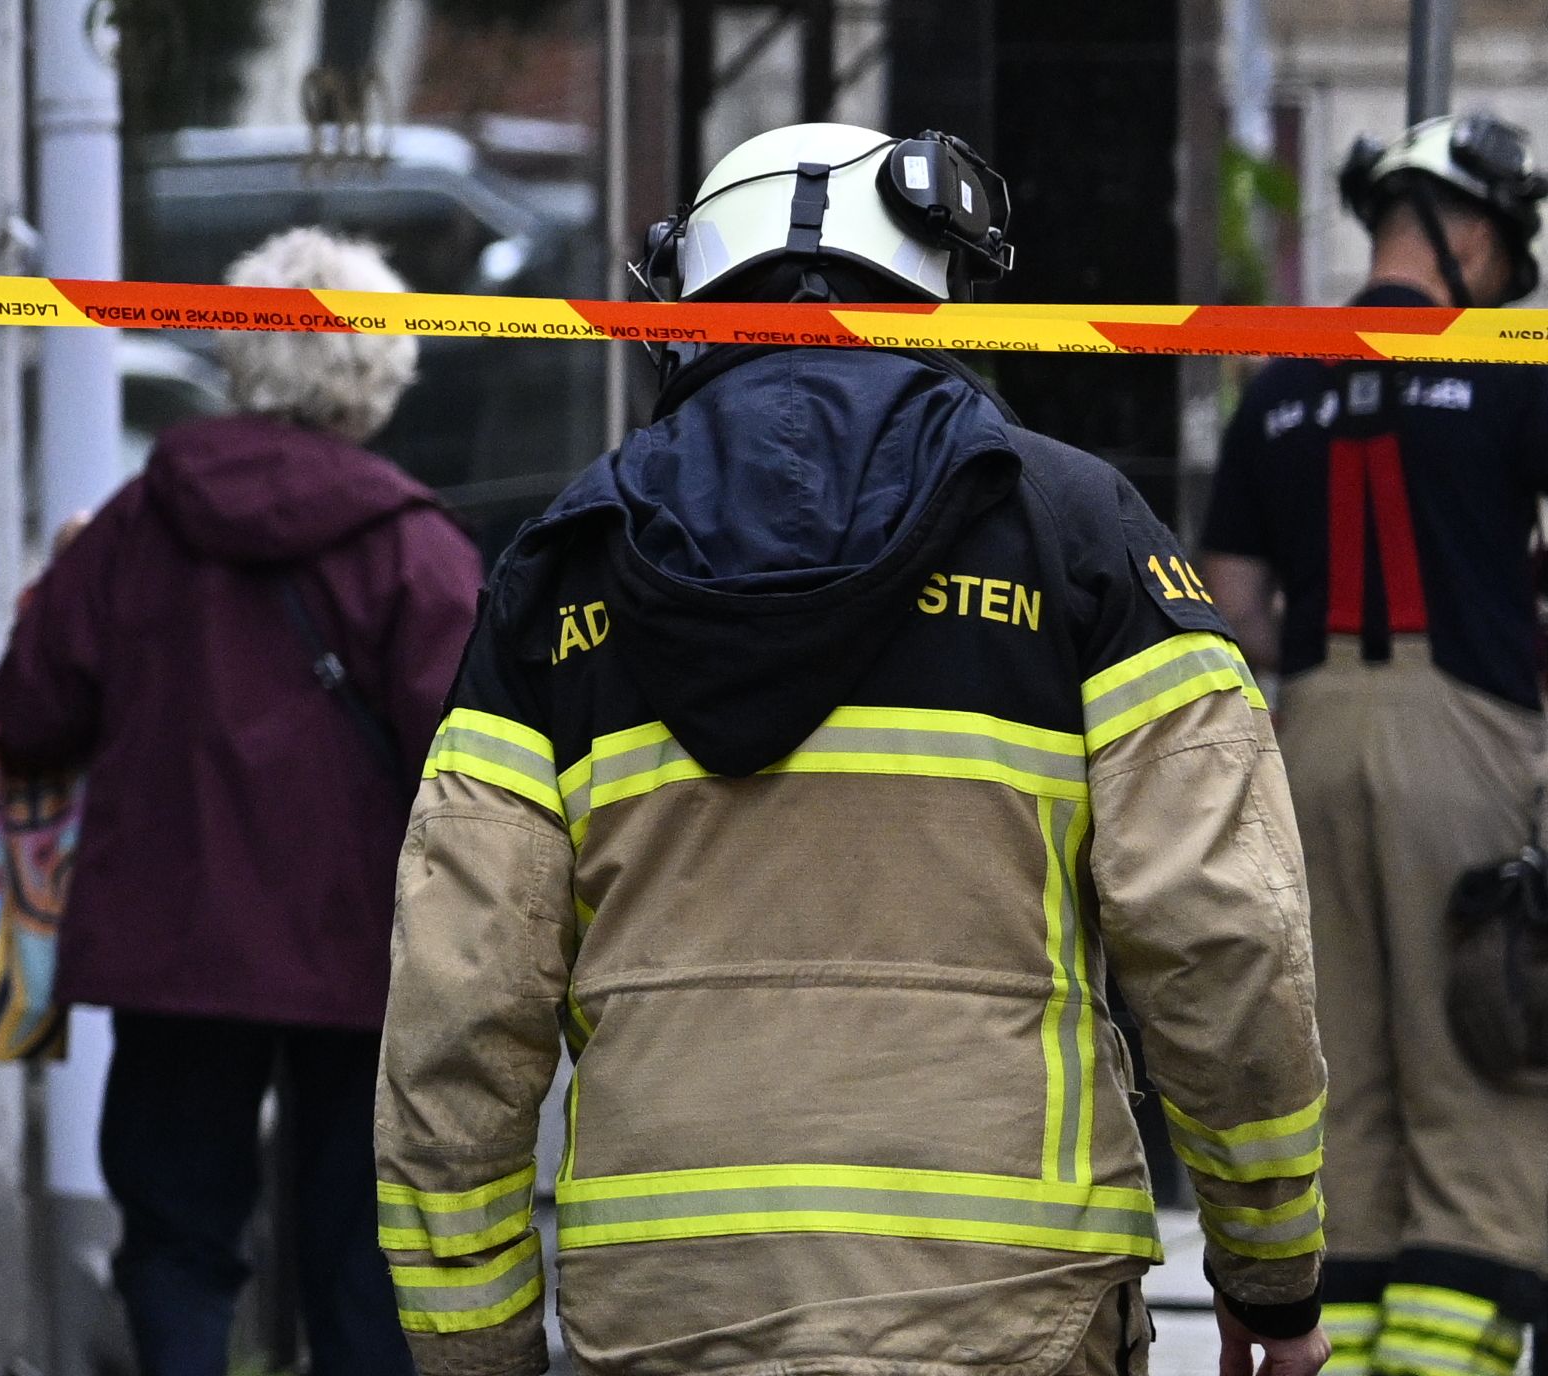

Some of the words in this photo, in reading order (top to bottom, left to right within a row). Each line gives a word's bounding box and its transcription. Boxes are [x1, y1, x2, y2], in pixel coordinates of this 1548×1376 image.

[405, 318, 491, 333] OLYCKOR
[498, 321, 537, 334] MOT
[544, 323, 605, 337] SKYDD
[611, 325, 640, 337] OM
[646, 327, 707, 339] LAGEN
[550, 599, 610, 666] ÄD
[916, 572, 1041, 632] STEN
